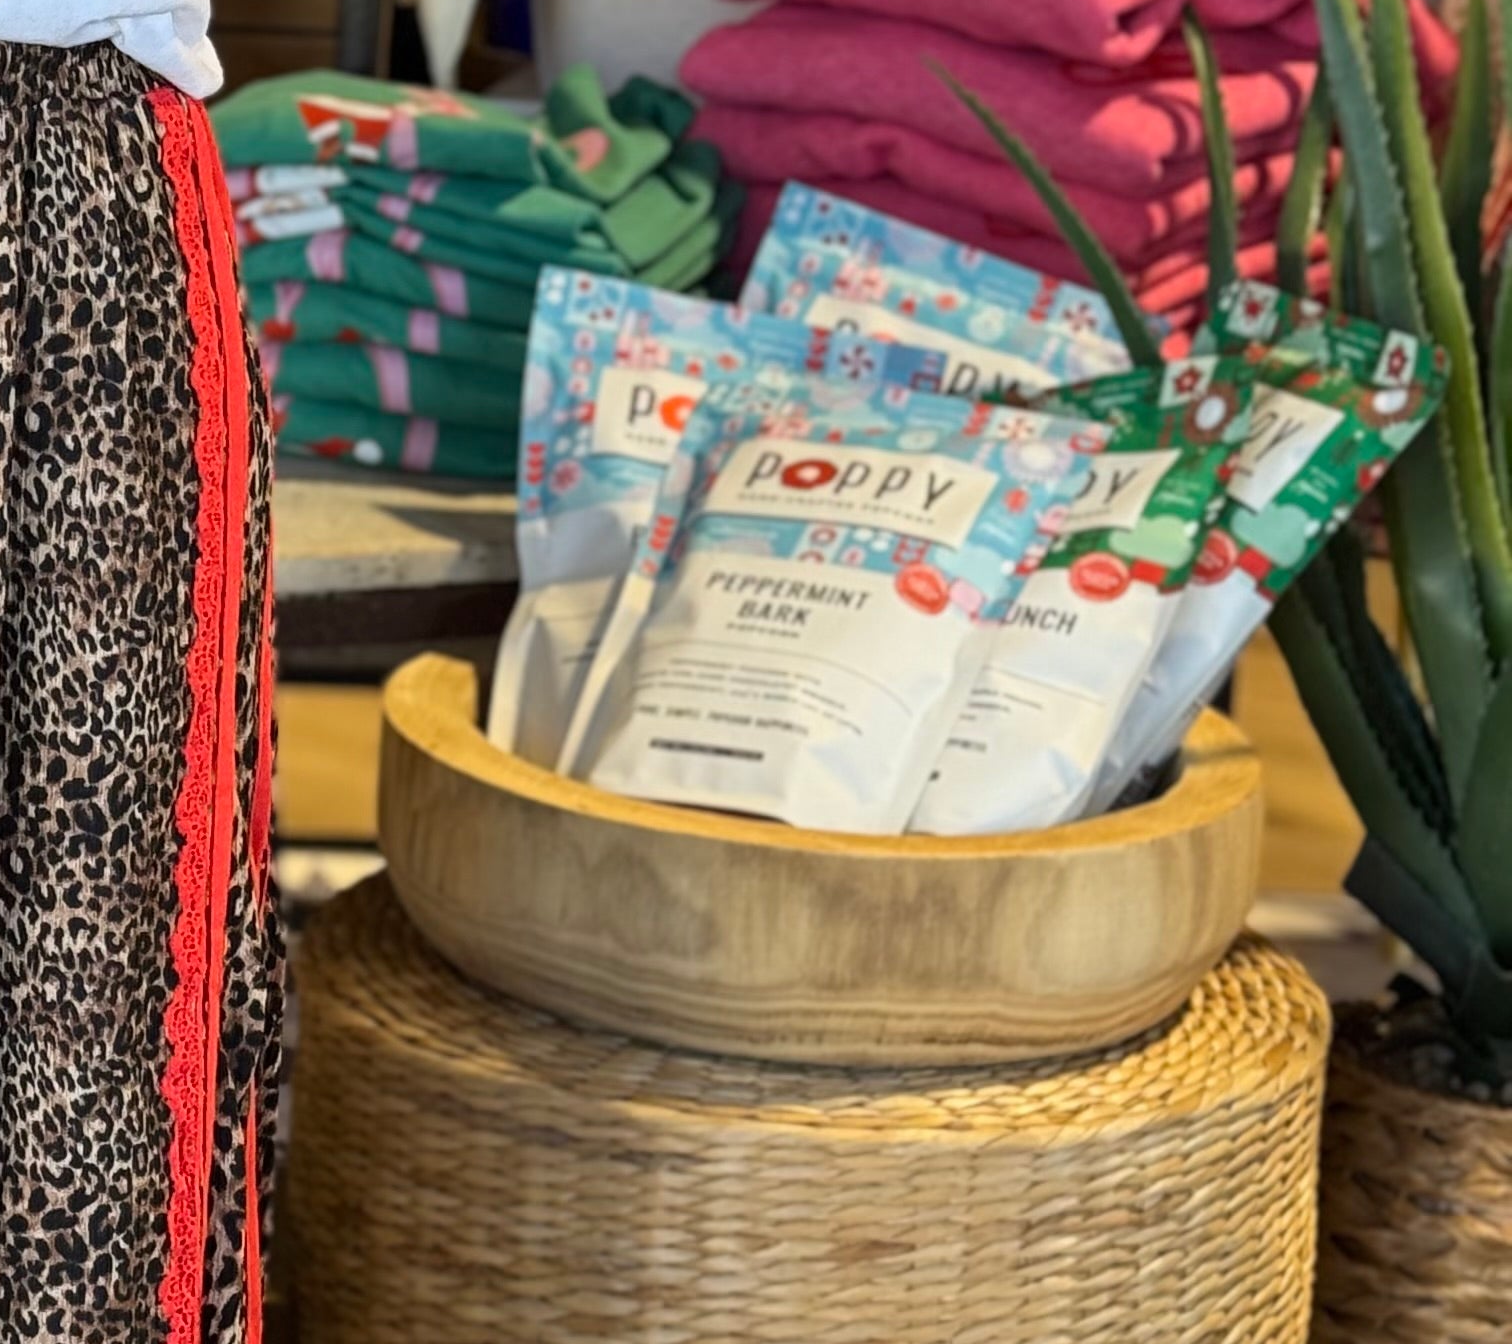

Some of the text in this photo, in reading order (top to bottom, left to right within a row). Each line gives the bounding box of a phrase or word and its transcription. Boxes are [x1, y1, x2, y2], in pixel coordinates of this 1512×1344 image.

[744, 451, 955, 512] POPPY
[705, 569, 871, 610] PEPPERMINT
[737, 600, 812, 626] BARK
